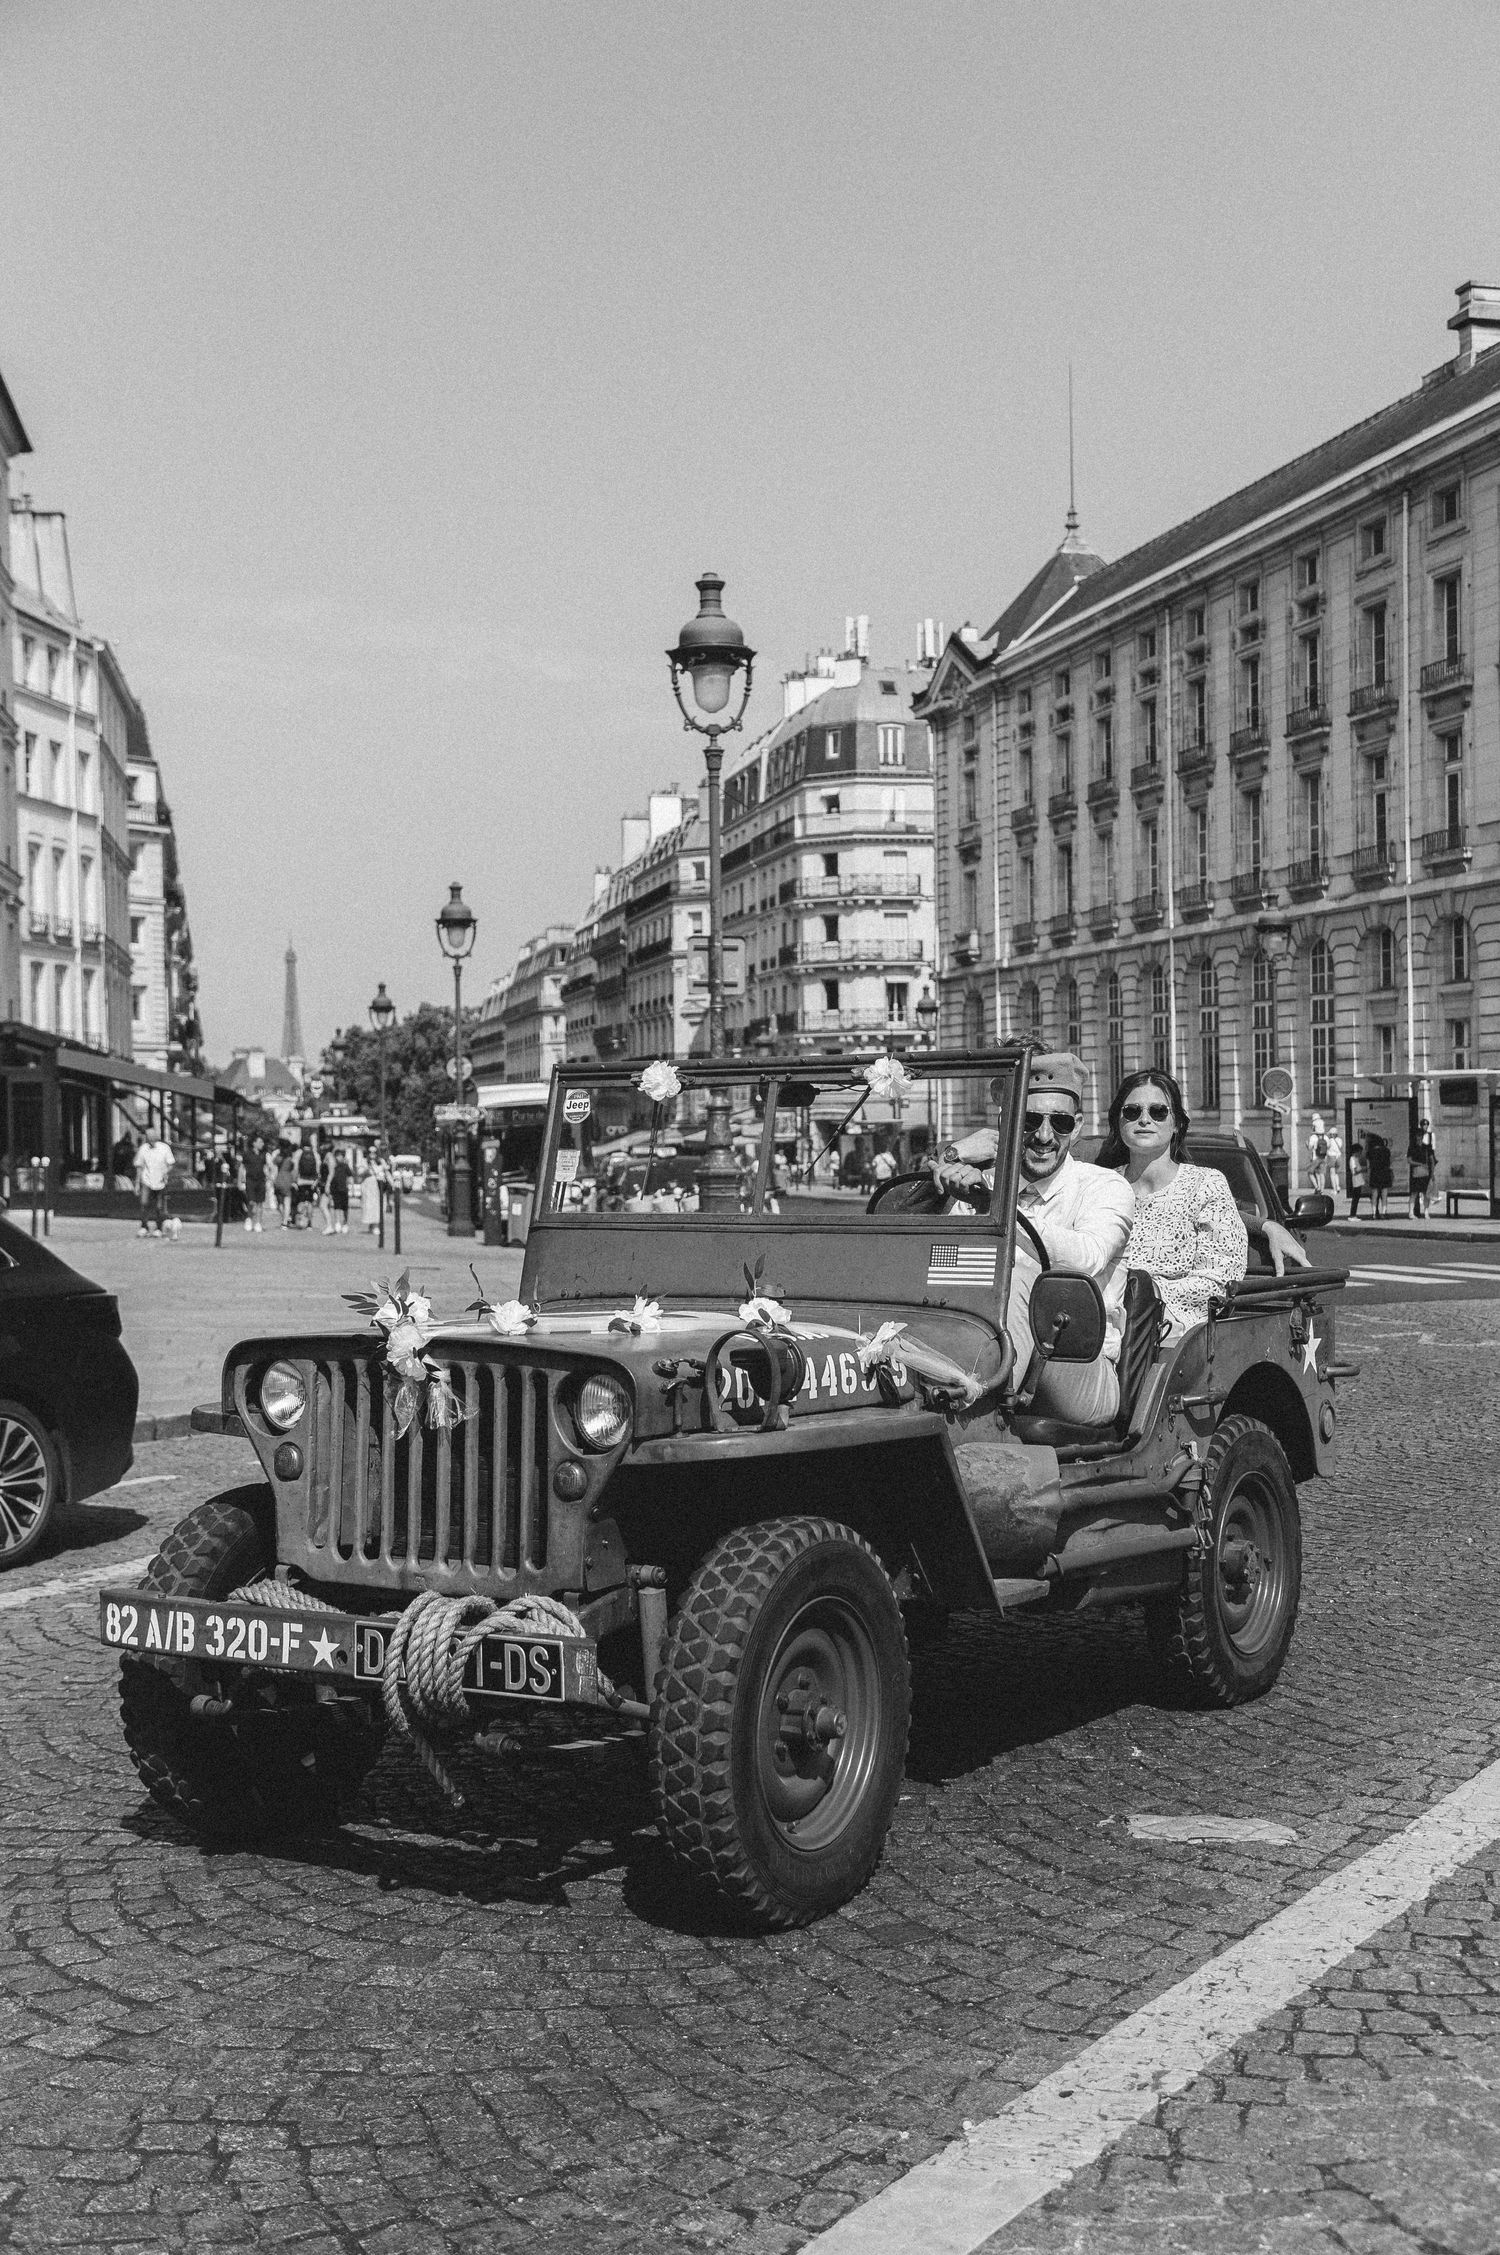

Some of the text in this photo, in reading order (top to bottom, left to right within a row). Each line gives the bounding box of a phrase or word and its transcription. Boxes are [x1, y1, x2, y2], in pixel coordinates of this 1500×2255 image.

[566, 1100, 589, 1111] Jeep
[106, 1602, 303, 1664] 82 A/B 320-F
